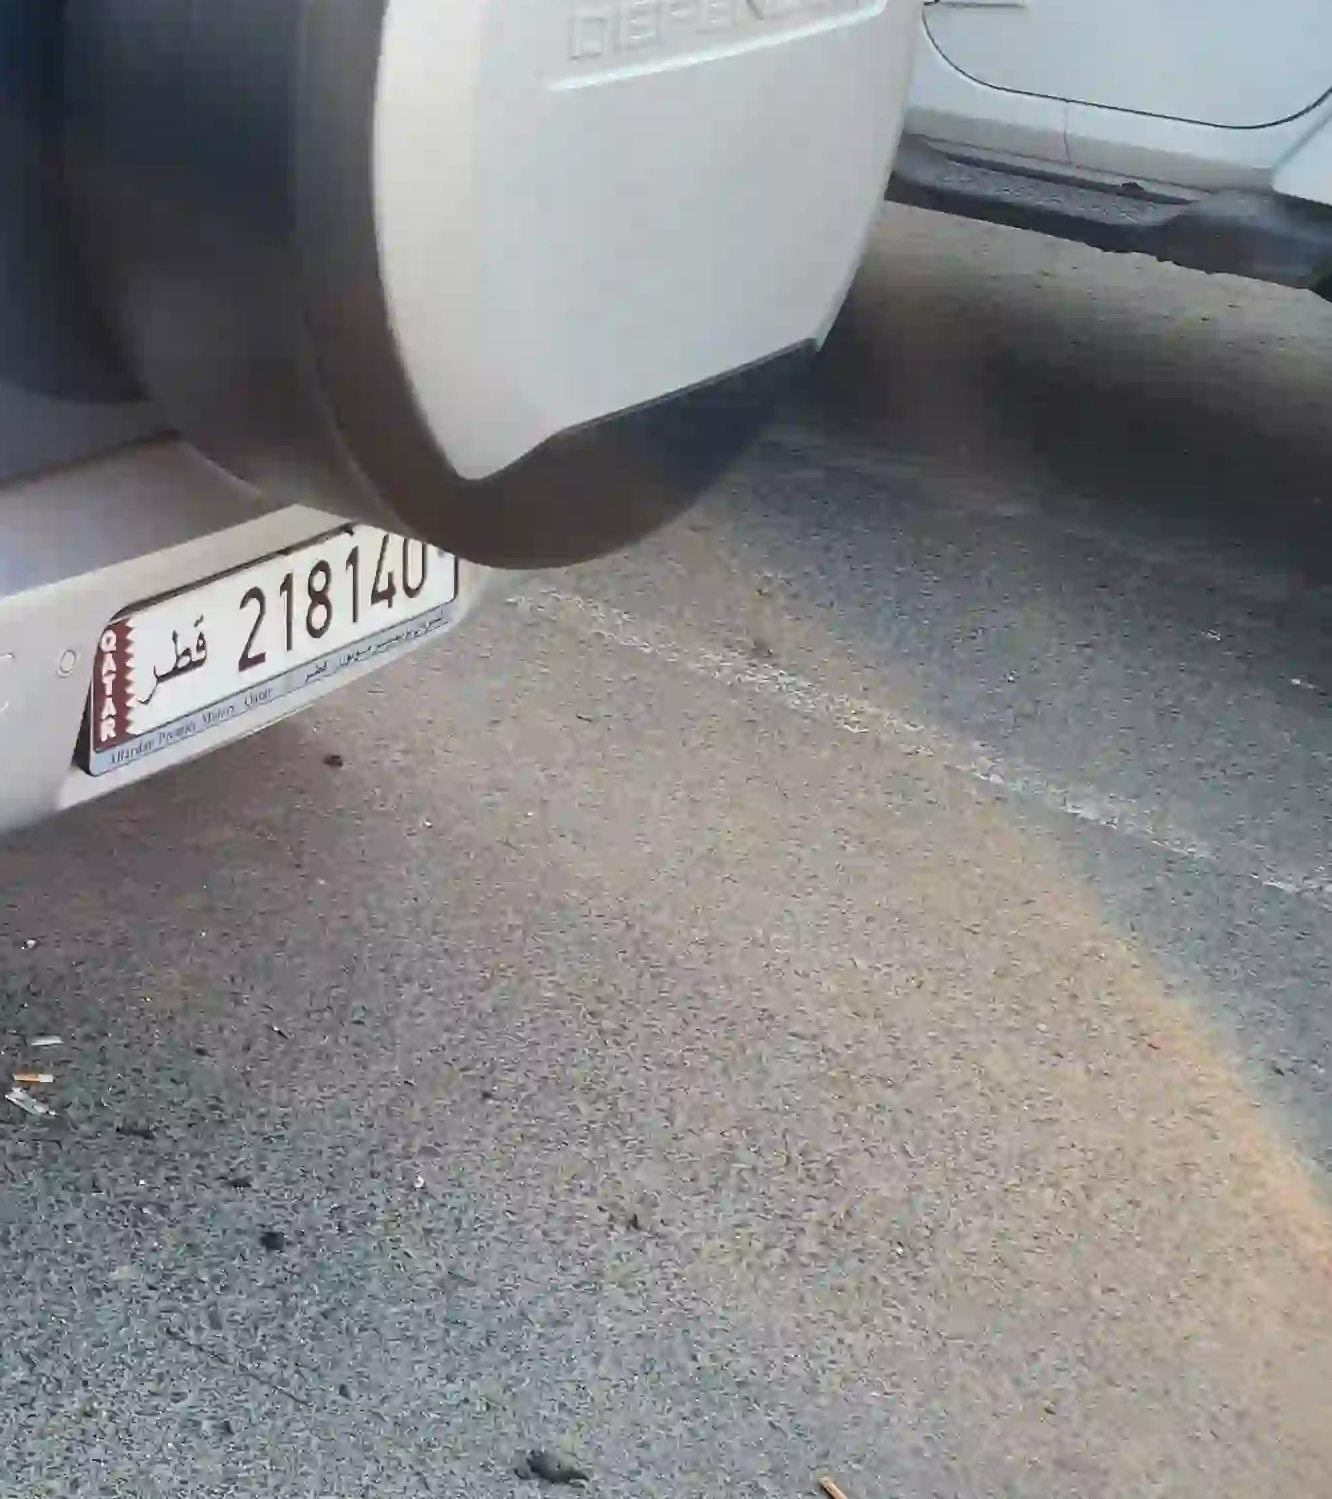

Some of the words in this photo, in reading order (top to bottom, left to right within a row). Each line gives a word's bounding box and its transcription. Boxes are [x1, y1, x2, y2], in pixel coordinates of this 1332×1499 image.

[238, 533, 428, 672] 218140
[100, 629, 117, 743] QATAR
[138, 614, 209, 706] قطر
